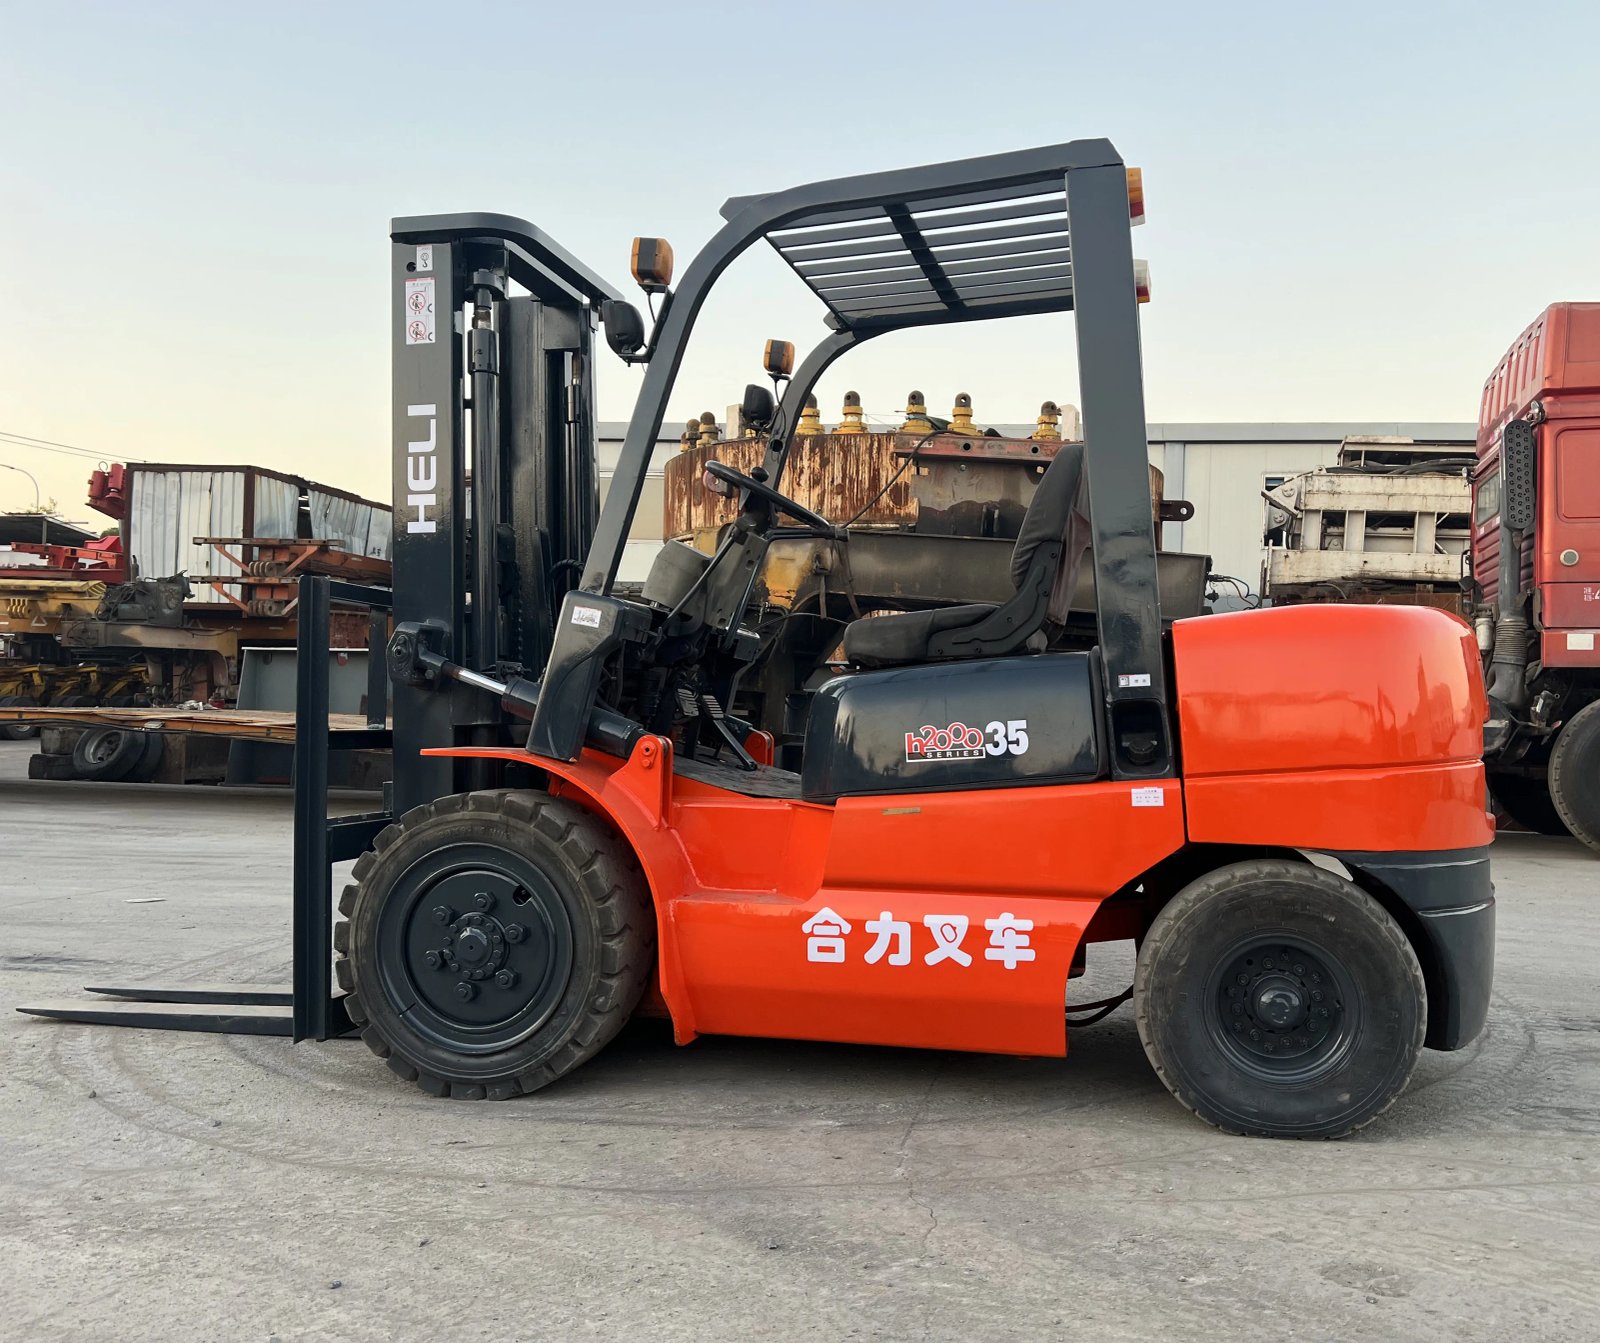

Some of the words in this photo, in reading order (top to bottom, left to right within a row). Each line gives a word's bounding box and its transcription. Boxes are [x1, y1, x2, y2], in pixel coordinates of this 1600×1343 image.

[407, 403, 437, 534] HELI
[926, 749, 980, 759] SERIES
[985, 719, 1029, 756] 35
[801, 906, 1036, 970] 合力叉车
